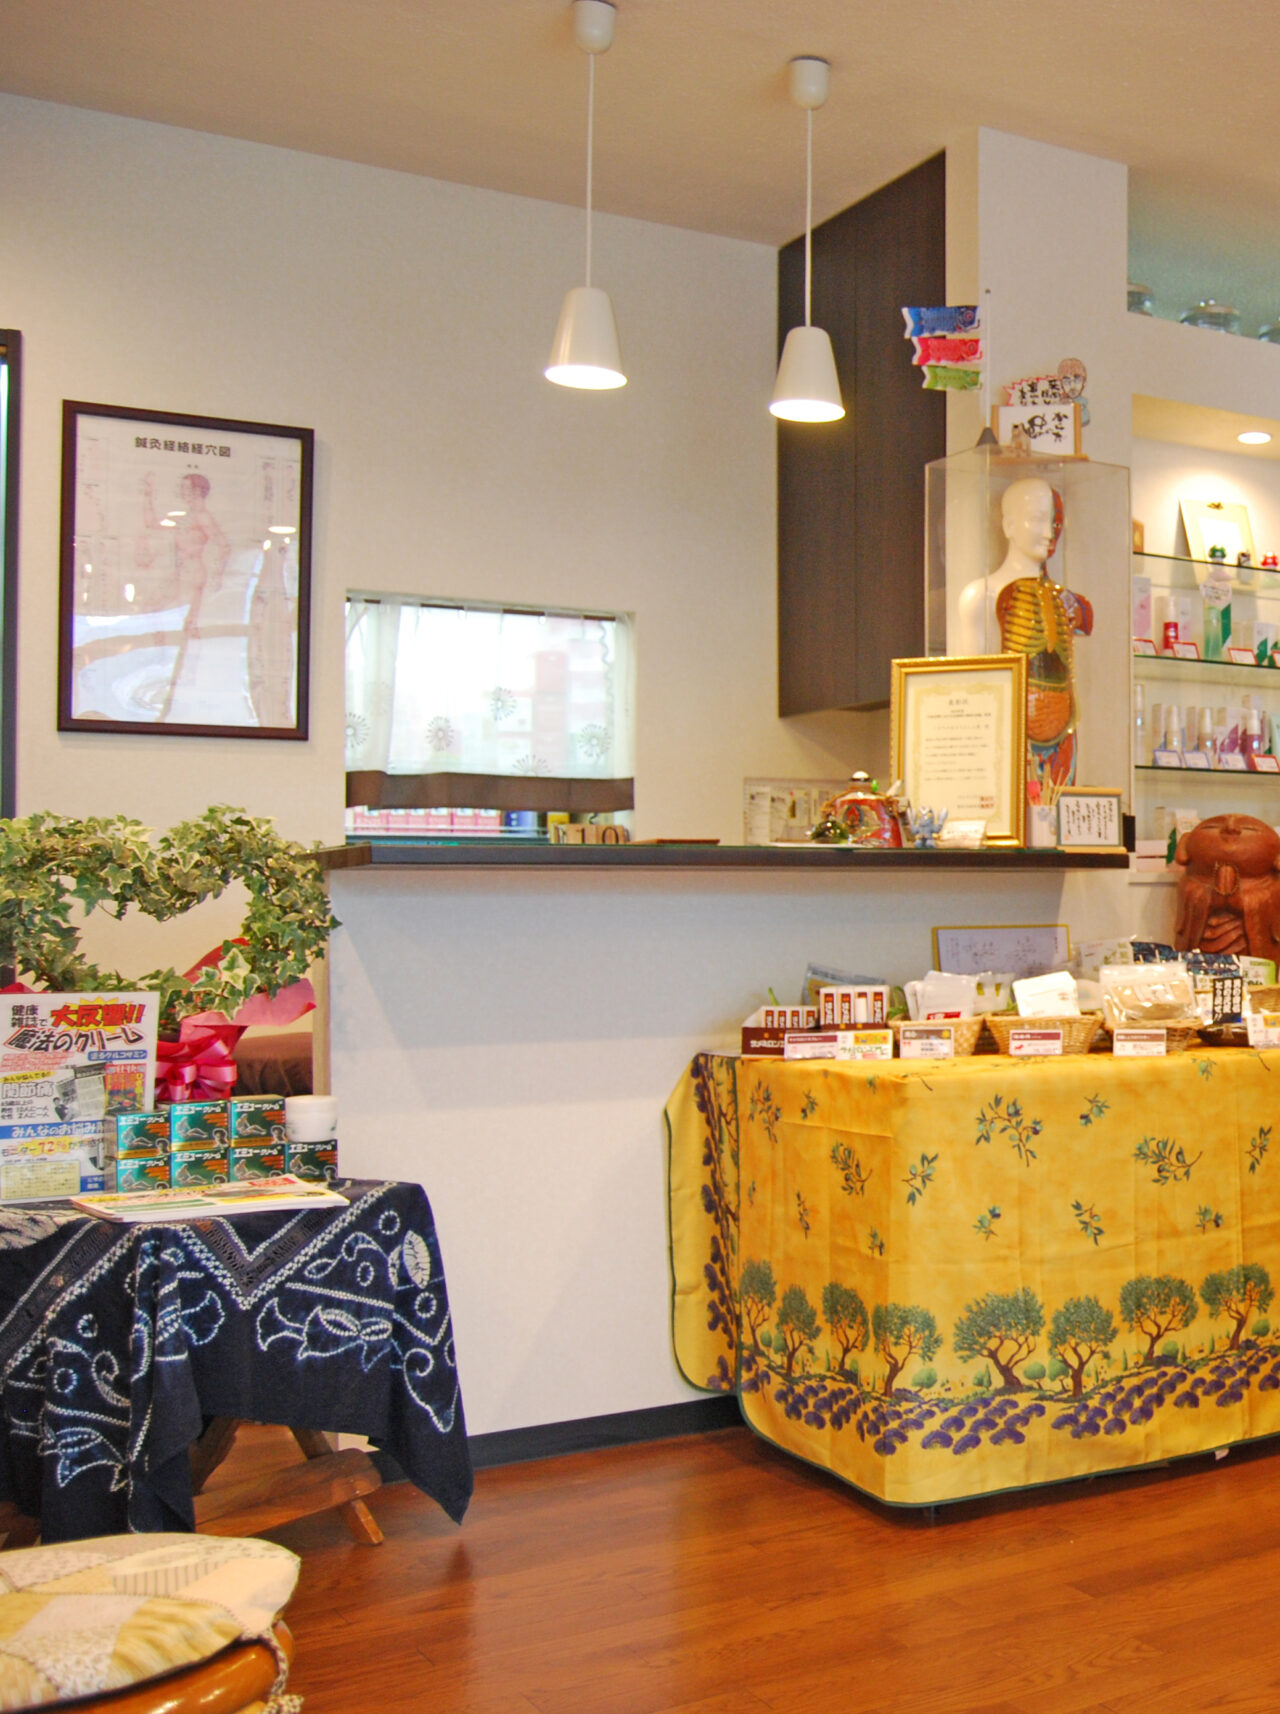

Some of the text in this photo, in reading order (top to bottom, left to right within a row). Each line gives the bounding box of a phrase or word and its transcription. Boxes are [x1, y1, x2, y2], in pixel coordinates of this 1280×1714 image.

[134, 436, 231, 458] 鍼灸経絡経穴図
